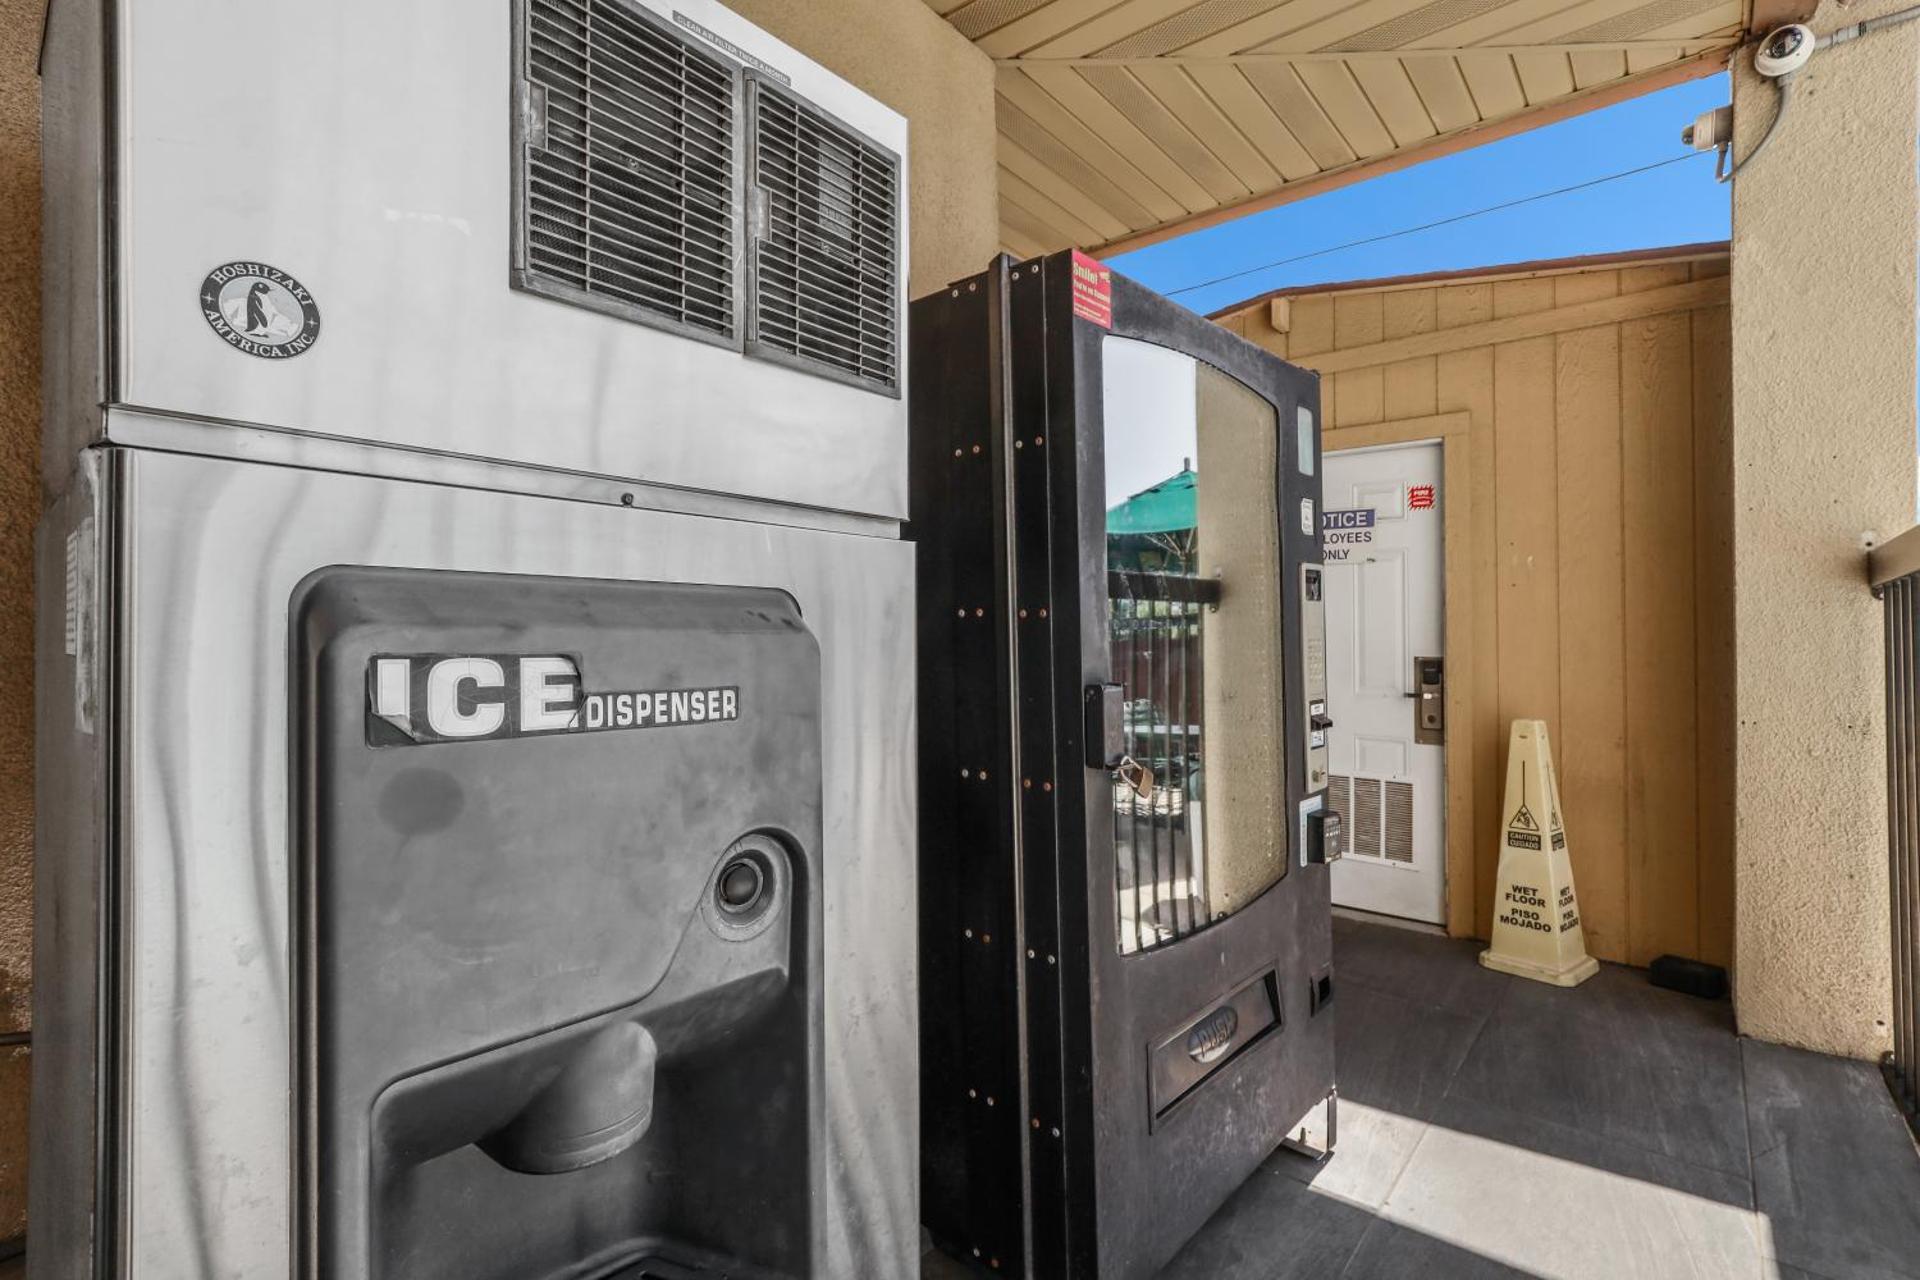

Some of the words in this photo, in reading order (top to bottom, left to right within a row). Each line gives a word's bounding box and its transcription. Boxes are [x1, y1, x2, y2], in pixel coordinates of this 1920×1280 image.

[210, 262, 314, 306] HOSHIZAKI
[1322, 511, 1368, 528] TICE
[1322, 531, 1372, 544] LOYEES
[376, 657, 579, 737] ICE
[586, 689, 738, 728] DISPENSER
[1511, 884, 1539, 897] WET
[1504, 892, 1547, 908] FLOOR
[1511, 908, 1540, 921] PISO
[1500, 914, 1552, 933] MOJADO
